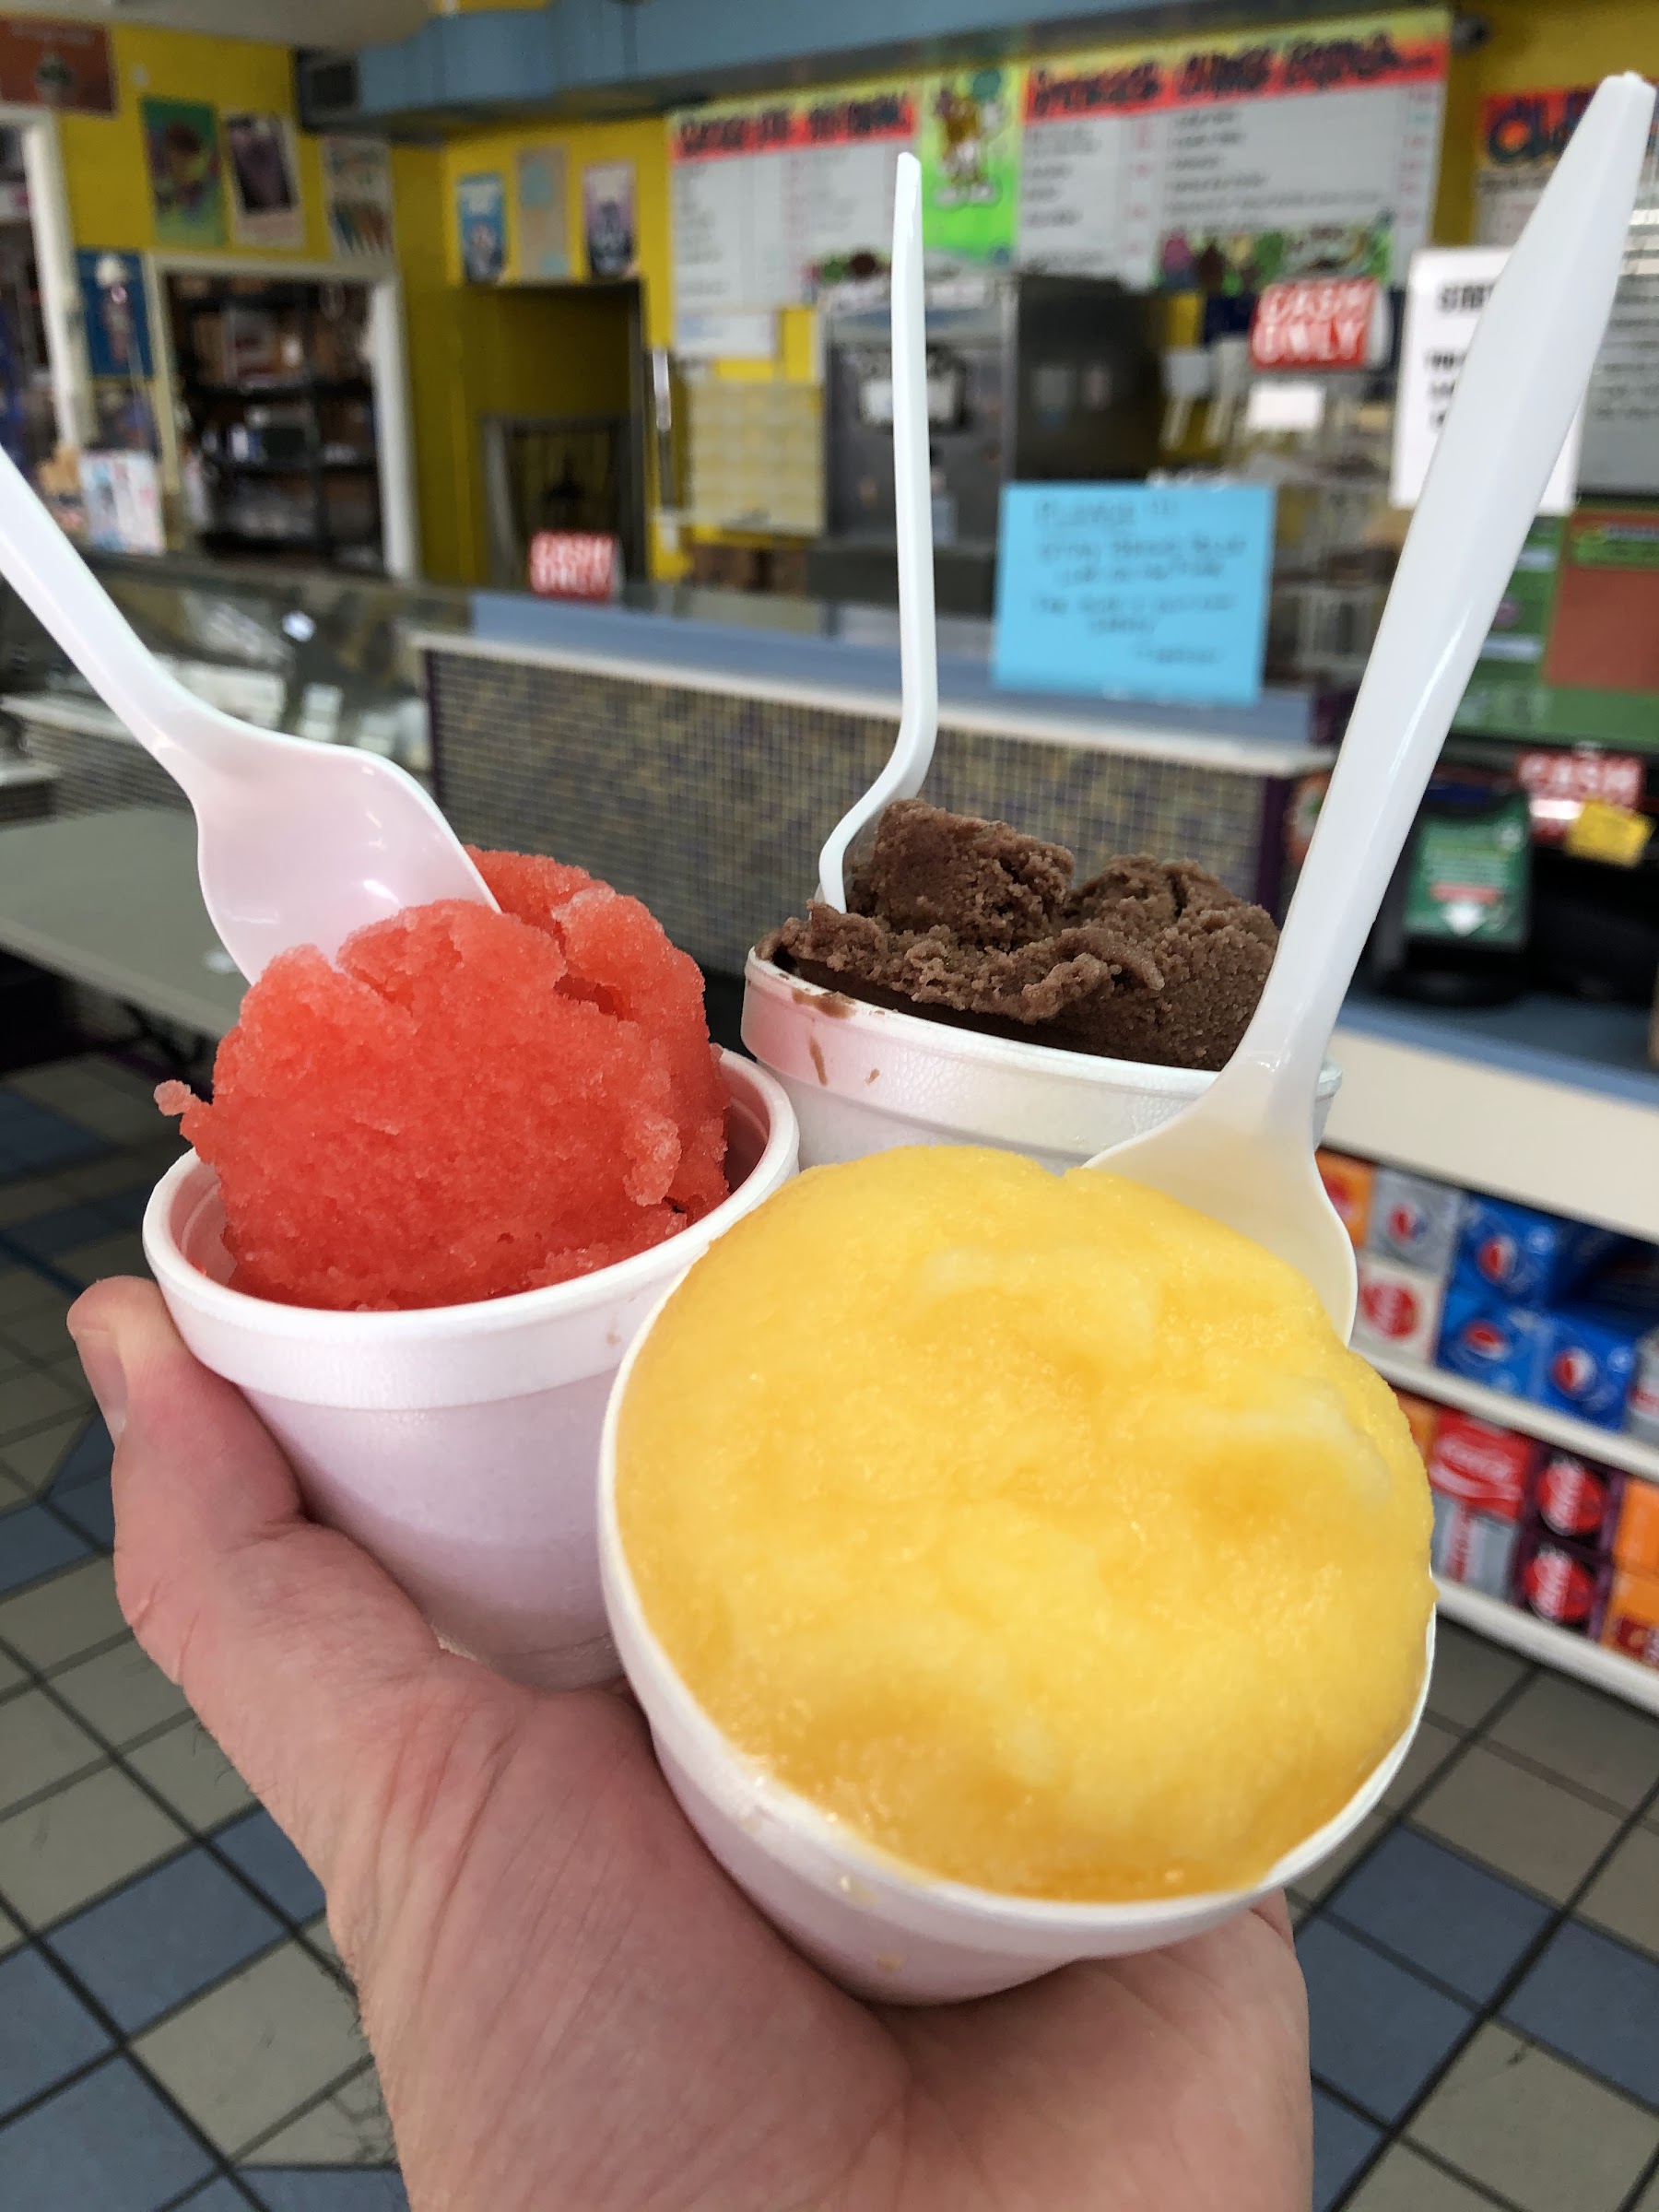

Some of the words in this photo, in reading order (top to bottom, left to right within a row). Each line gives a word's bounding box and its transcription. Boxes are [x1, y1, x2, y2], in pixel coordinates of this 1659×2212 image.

[1259, 282, 1371, 323] CASH
[1253, 322, 1367, 362] ONLY
[1521, 753, 1641, 802] CASH
